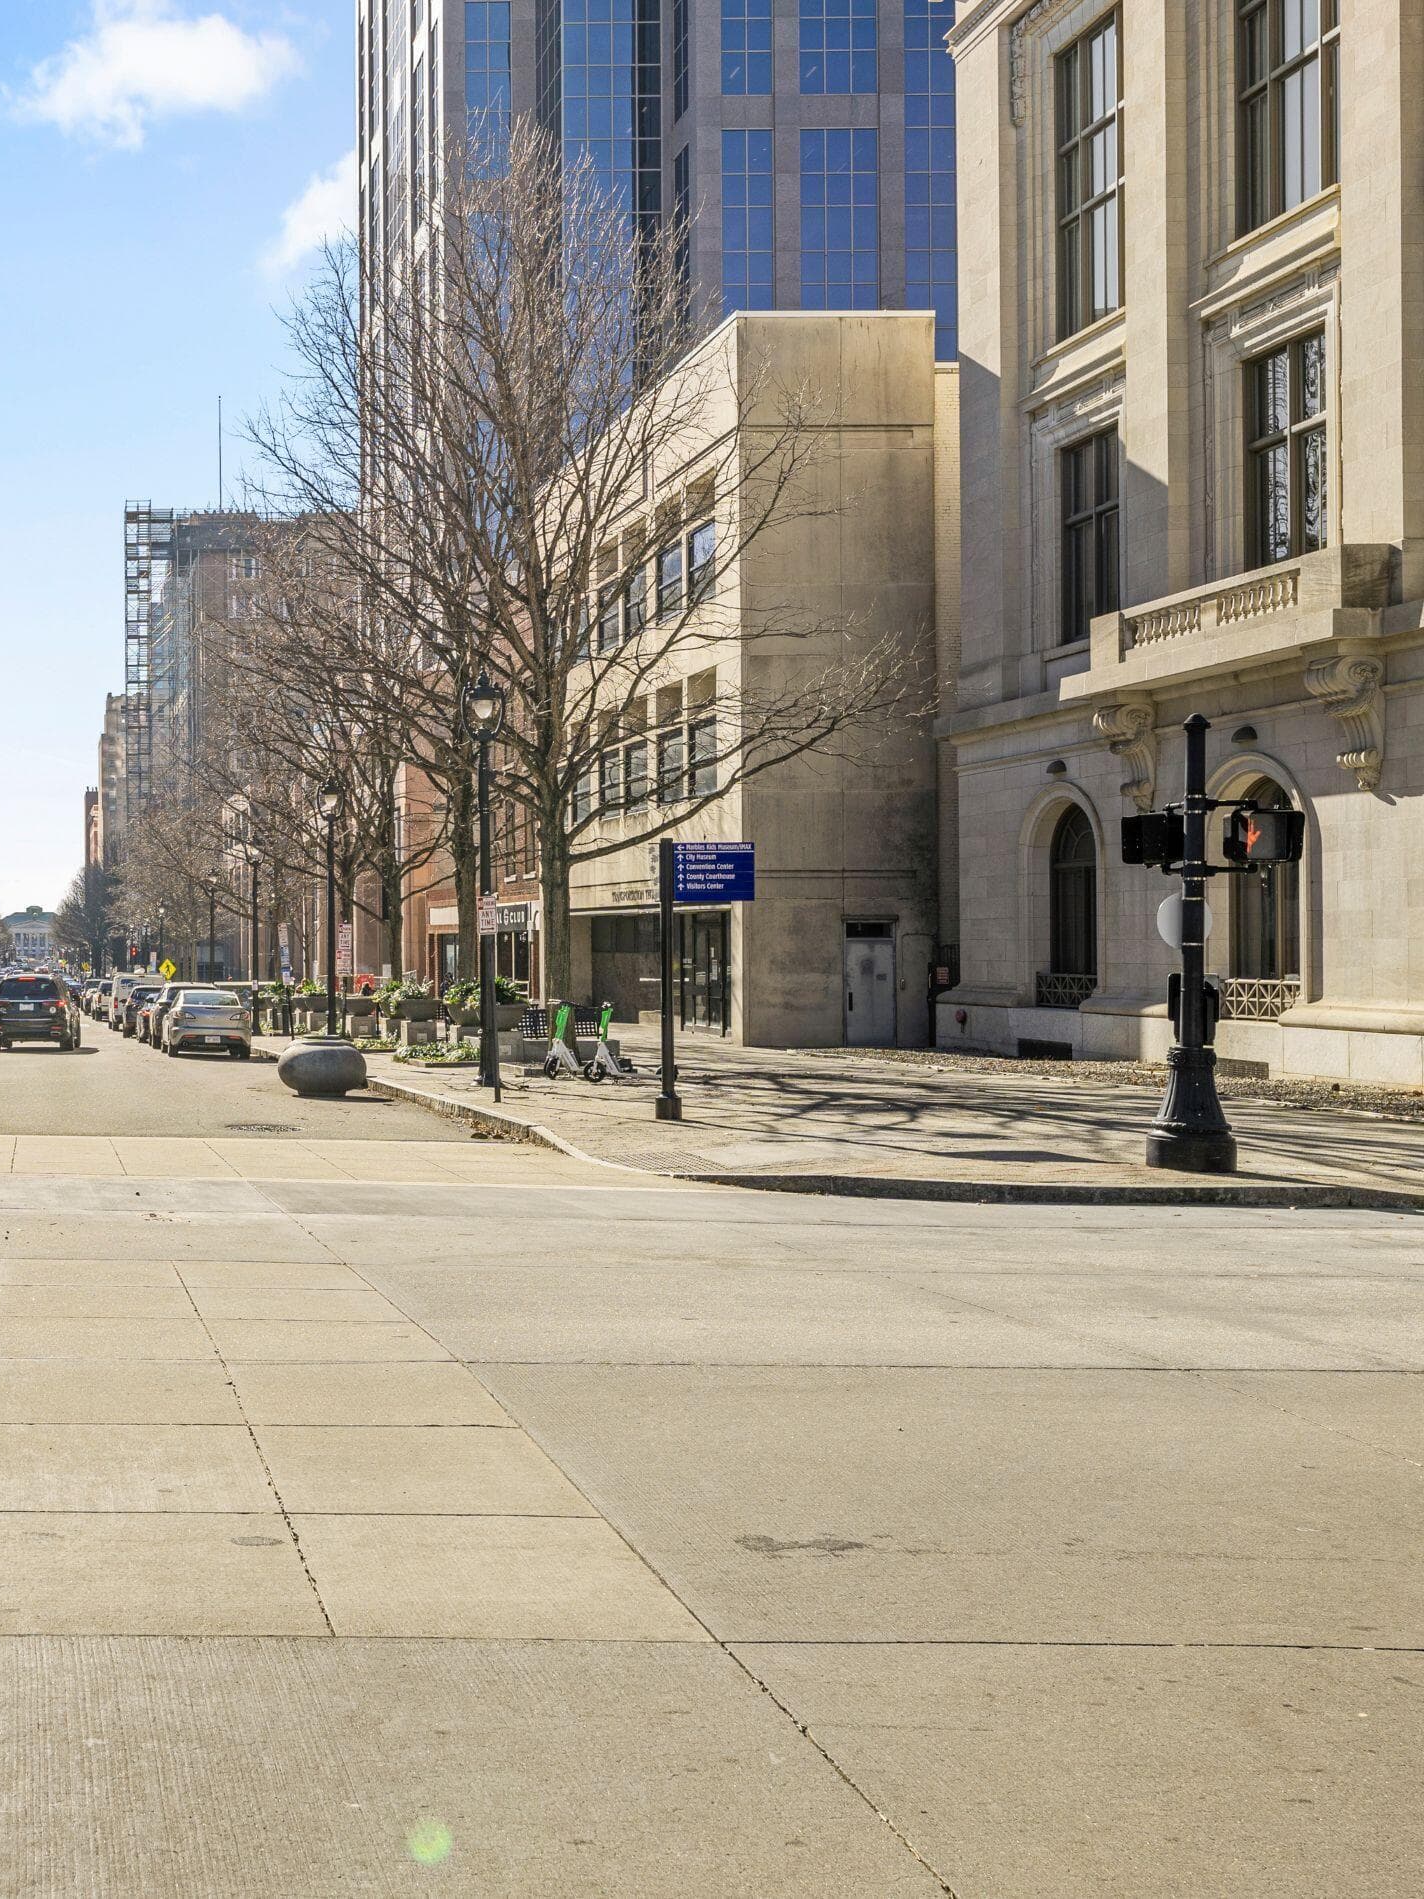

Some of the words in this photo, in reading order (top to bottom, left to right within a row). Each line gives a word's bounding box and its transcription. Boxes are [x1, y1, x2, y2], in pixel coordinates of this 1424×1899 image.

[686, 873, 704, 881] County
[509, 911, 525, 923] CLUB
[480, 918, 495, 927] TIME
